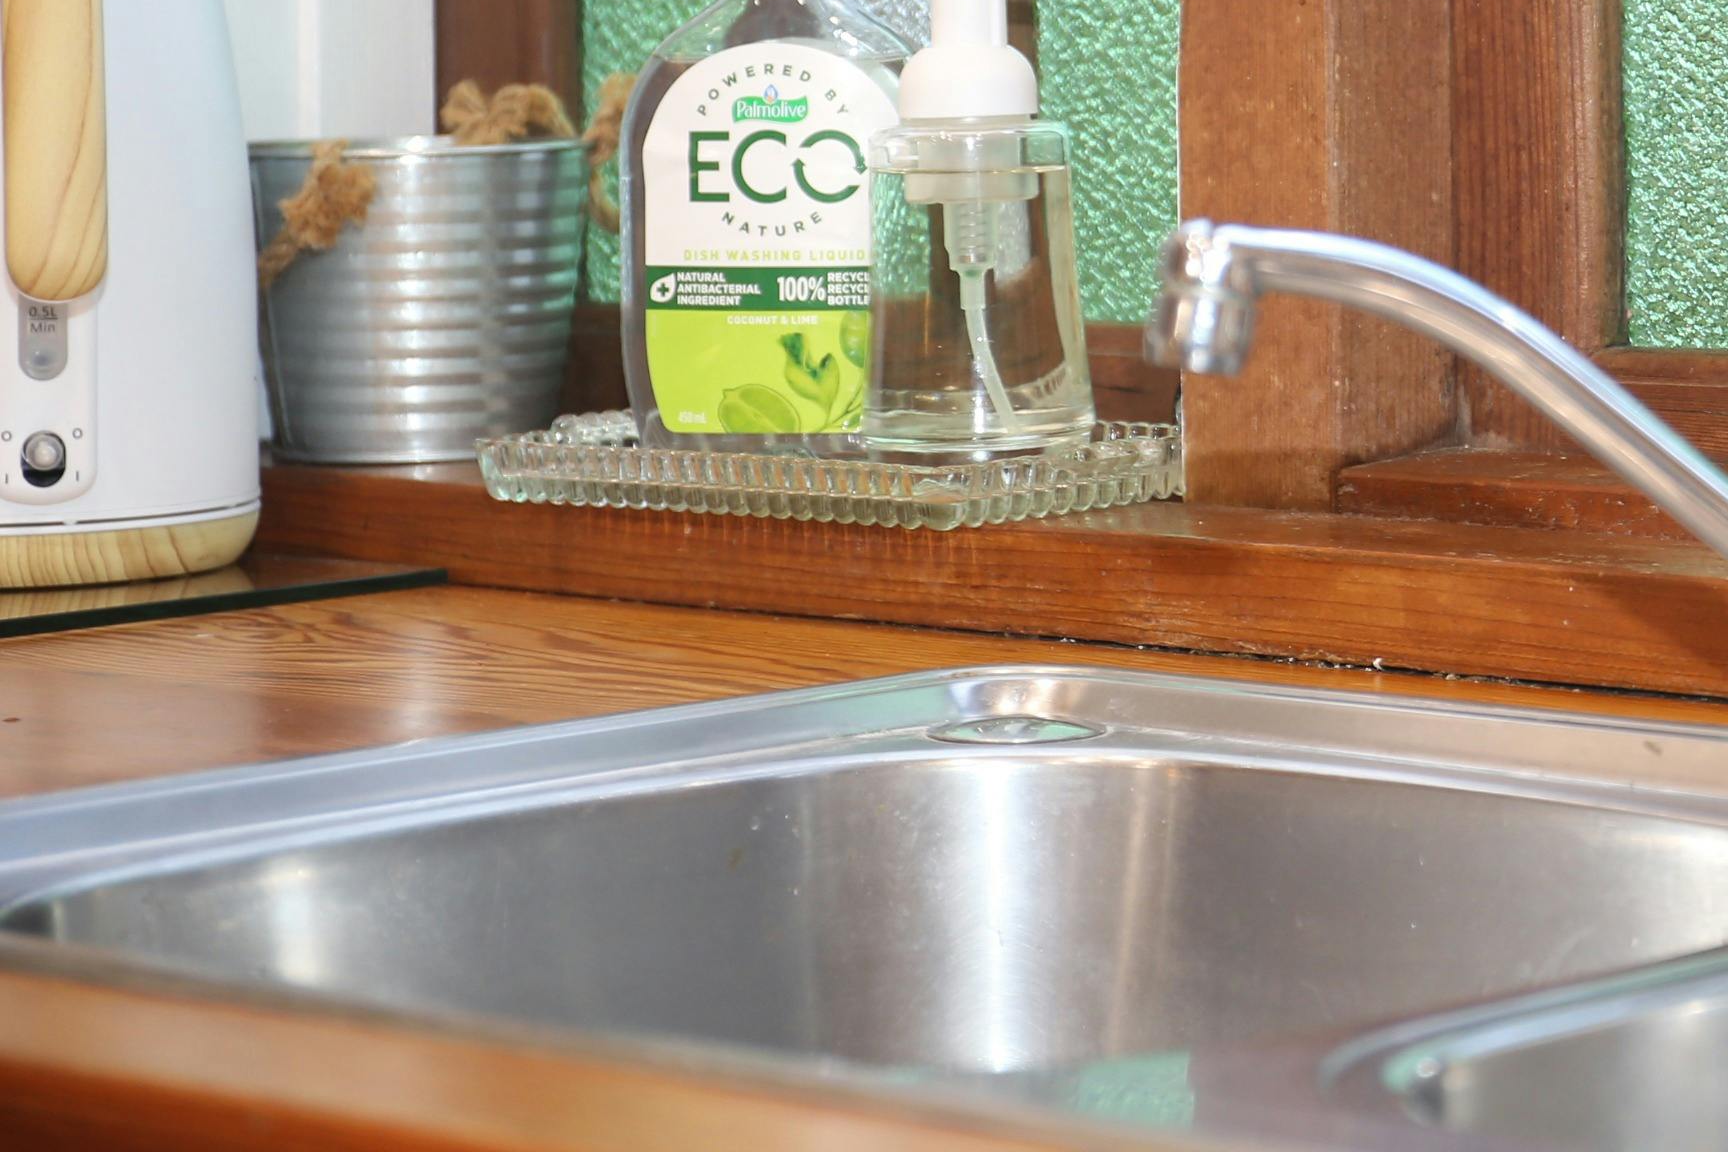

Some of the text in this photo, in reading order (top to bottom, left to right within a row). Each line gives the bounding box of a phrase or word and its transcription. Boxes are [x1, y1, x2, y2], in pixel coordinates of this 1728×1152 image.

[697, 63, 849, 117] POWERED BY
[736, 100, 806, 118] Palmolive
[689, 129, 868, 204] ECO
[722, 211, 822, 237] NATURE
[684, 249, 866, 261] DISH WASHING LIQUID
[677, 272, 726, 283] NATURAL
[677, 284, 761, 295] ANTIBACTERIAL
[776, 276, 826, 302] 100%
[677, 295, 741, 306] INGREDIENT
[28, 305, 57, 317] 0.5L
[727, 315, 777, 325] COCONUT
[791, 315, 819, 325] LIME
[30, 322, 55, 333] Min
